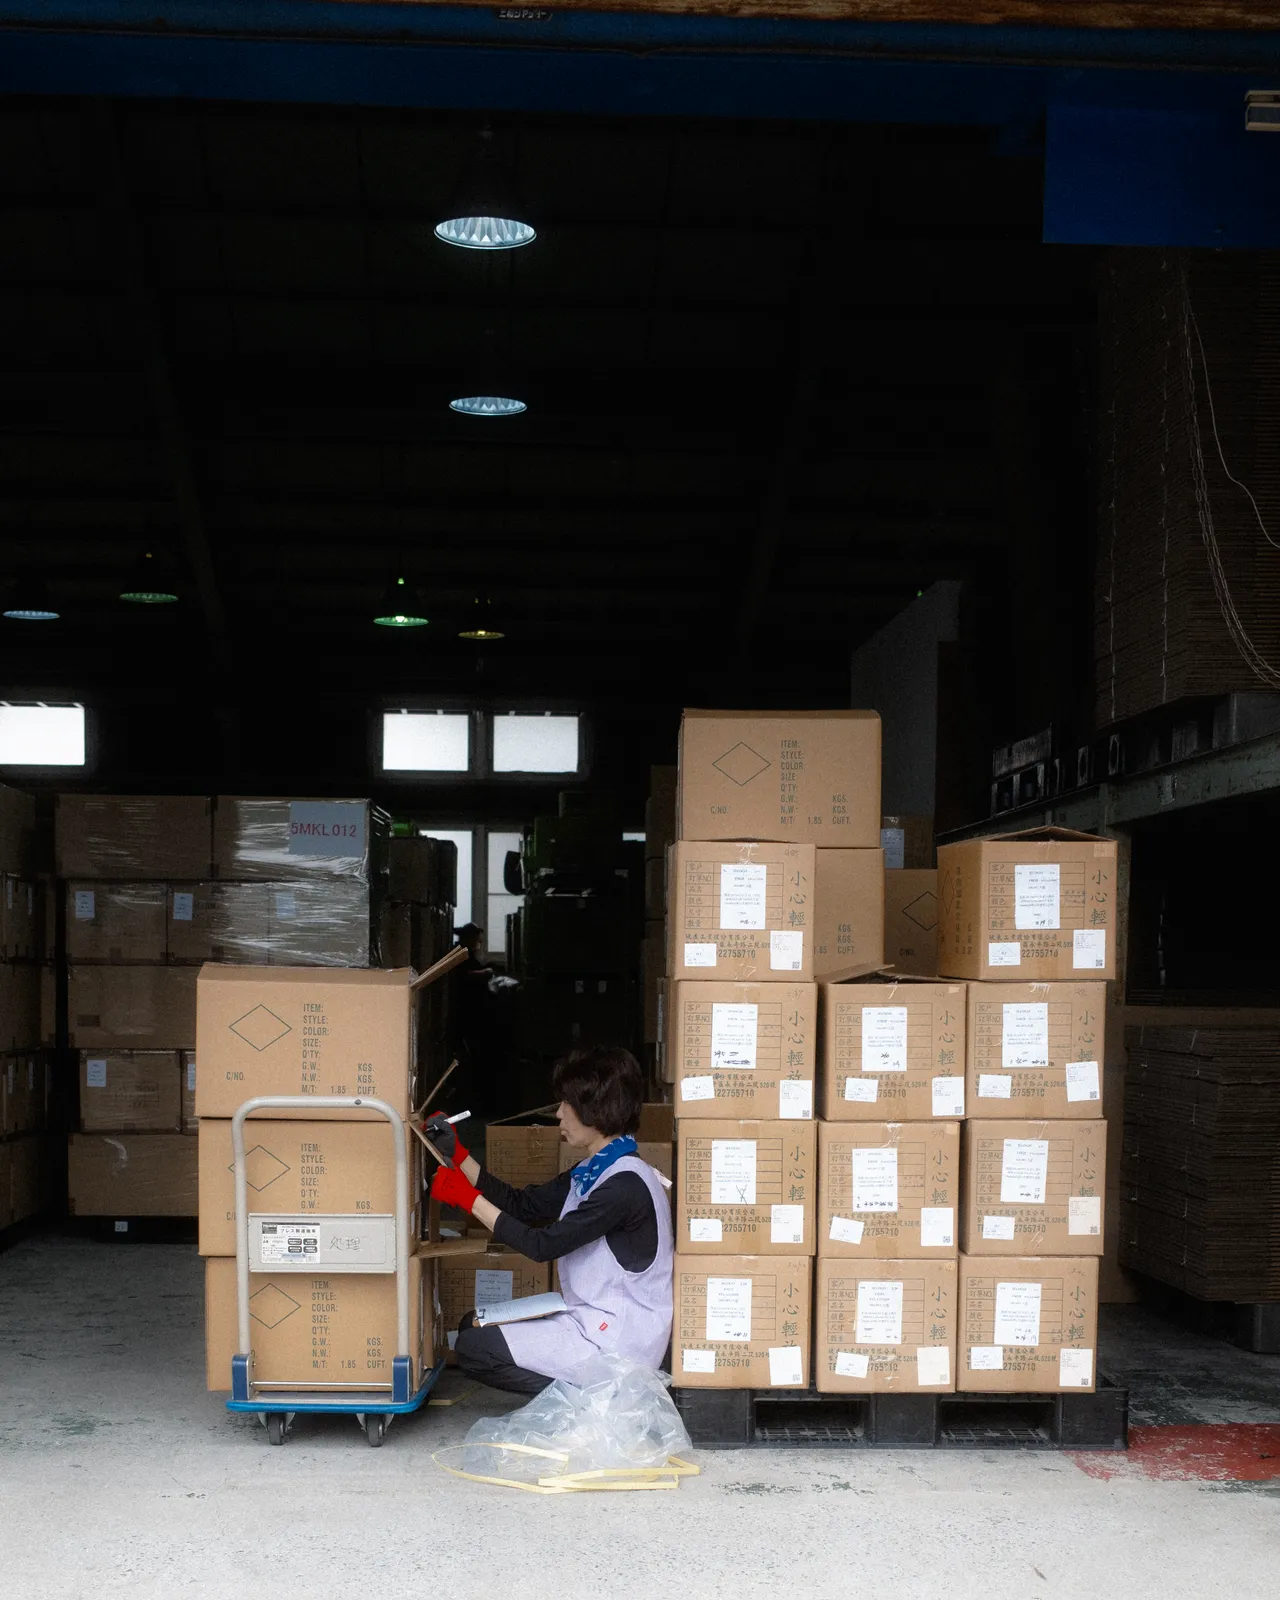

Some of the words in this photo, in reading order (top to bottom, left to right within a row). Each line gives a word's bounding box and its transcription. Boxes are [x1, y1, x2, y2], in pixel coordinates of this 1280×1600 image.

[780, 740, 800, 748] ITEM:
[780, 751, 805, 760] STYLE:
[832, 795, 849, 803] KGS.
[832, 805, 848, 814] KGS.
[807, 816, 822, 825] 1.85
[291, 823, 357, 838] 5MKL012
[837, 924, 854, 932] KGS.
[837, 935, 854, 944] KGS.
[718, 950, 756, 958] 22755710
[303, 1003, 324, 1013] ITEM:
[303, 1015, 329, 1025] STYLE:
[303, 1026, 329, 1036] COLOR:
[302, 1038, 321, 1048] SIZE:
[302, 1050, 321, 1059] Q'TY:
[302, 1061, 321, 1071] G.W.:
[357, 1063, 375, 1072] KGS.
[226, 1071, 246, 1081] C/NO.
[302, 1073, 321, 1082] N.W.:
[357, 1074, 375, 1084] KGS.
[301, 1084, 317, 1094] M/T:
[330, 1085, 346, 1094] 1.85
[357, 1086, 378, 1095] CUFT.
[300, 1143, 321, 1152] ITEM:
[300, 1155, 326, 1164] STYLE:
[300, 1166, 328, 1175] COLOR:
[300, 1177, 319, 1186] SIZE:
[300, 1189, 320, 1198] Q'TY:
[300, 1200, 320, 1209] G.W.:
[356, 1201, 373, 1210] KGS.
[722, 1224, 757, 1232] 2755710
[311, 1281, 331, 1289] ITEM:
[311, 1292, 336, 1300] STYLE:
[311, 1304, 338, 1312] COLOR:
[311, 1315, 330, 1324] SIZE:
[929, 1286, 947, 1347] 小心輕
[312, 1326, 330, 1335] Q'TY:
[312, 1338, 331, 1346] G.W.:
[366, 1338, 383, 1346] KGS.
[312, 1349, 331, 1358] N.W.:
[366, 1349, 384, 1358] KGS.
[312, 1360, 328, 1369] M/T:
[341, 1360, 356, 1369] 1.85
[366, 1360, 387, 1369] CUFT.
